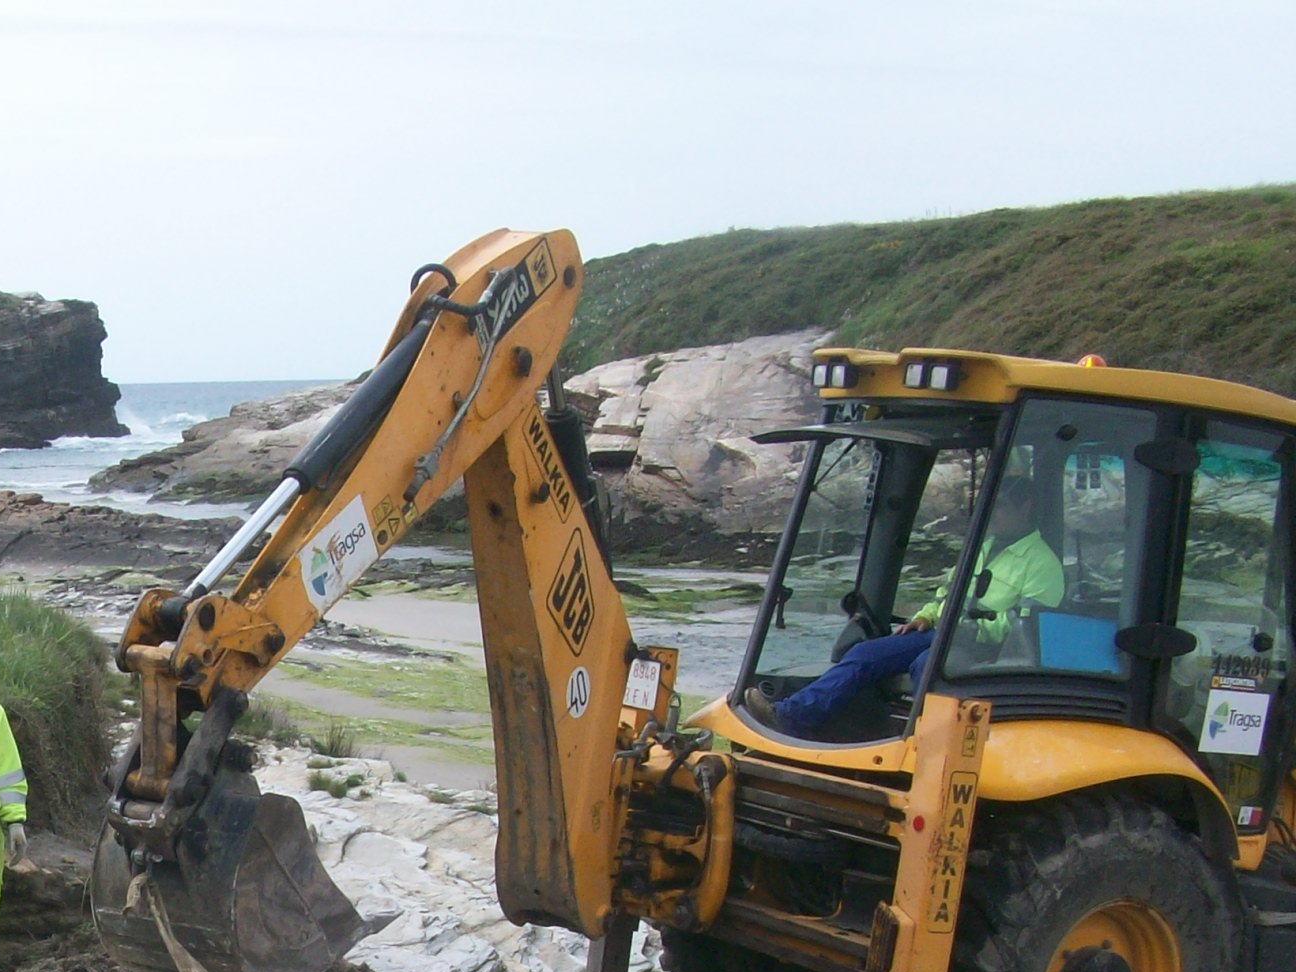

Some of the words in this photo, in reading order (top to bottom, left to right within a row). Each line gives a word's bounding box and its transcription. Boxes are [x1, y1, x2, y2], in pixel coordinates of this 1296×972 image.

[528, 415, 570, 514] WALKIA
[552, 547, 591, 646] JCB
[570, 669, 588, 713] 40
[633, 662, 657, 681] 8948
[1229, 709, 1262, 731] Tragsa
[934, 784, 973, 923] WALKIA
